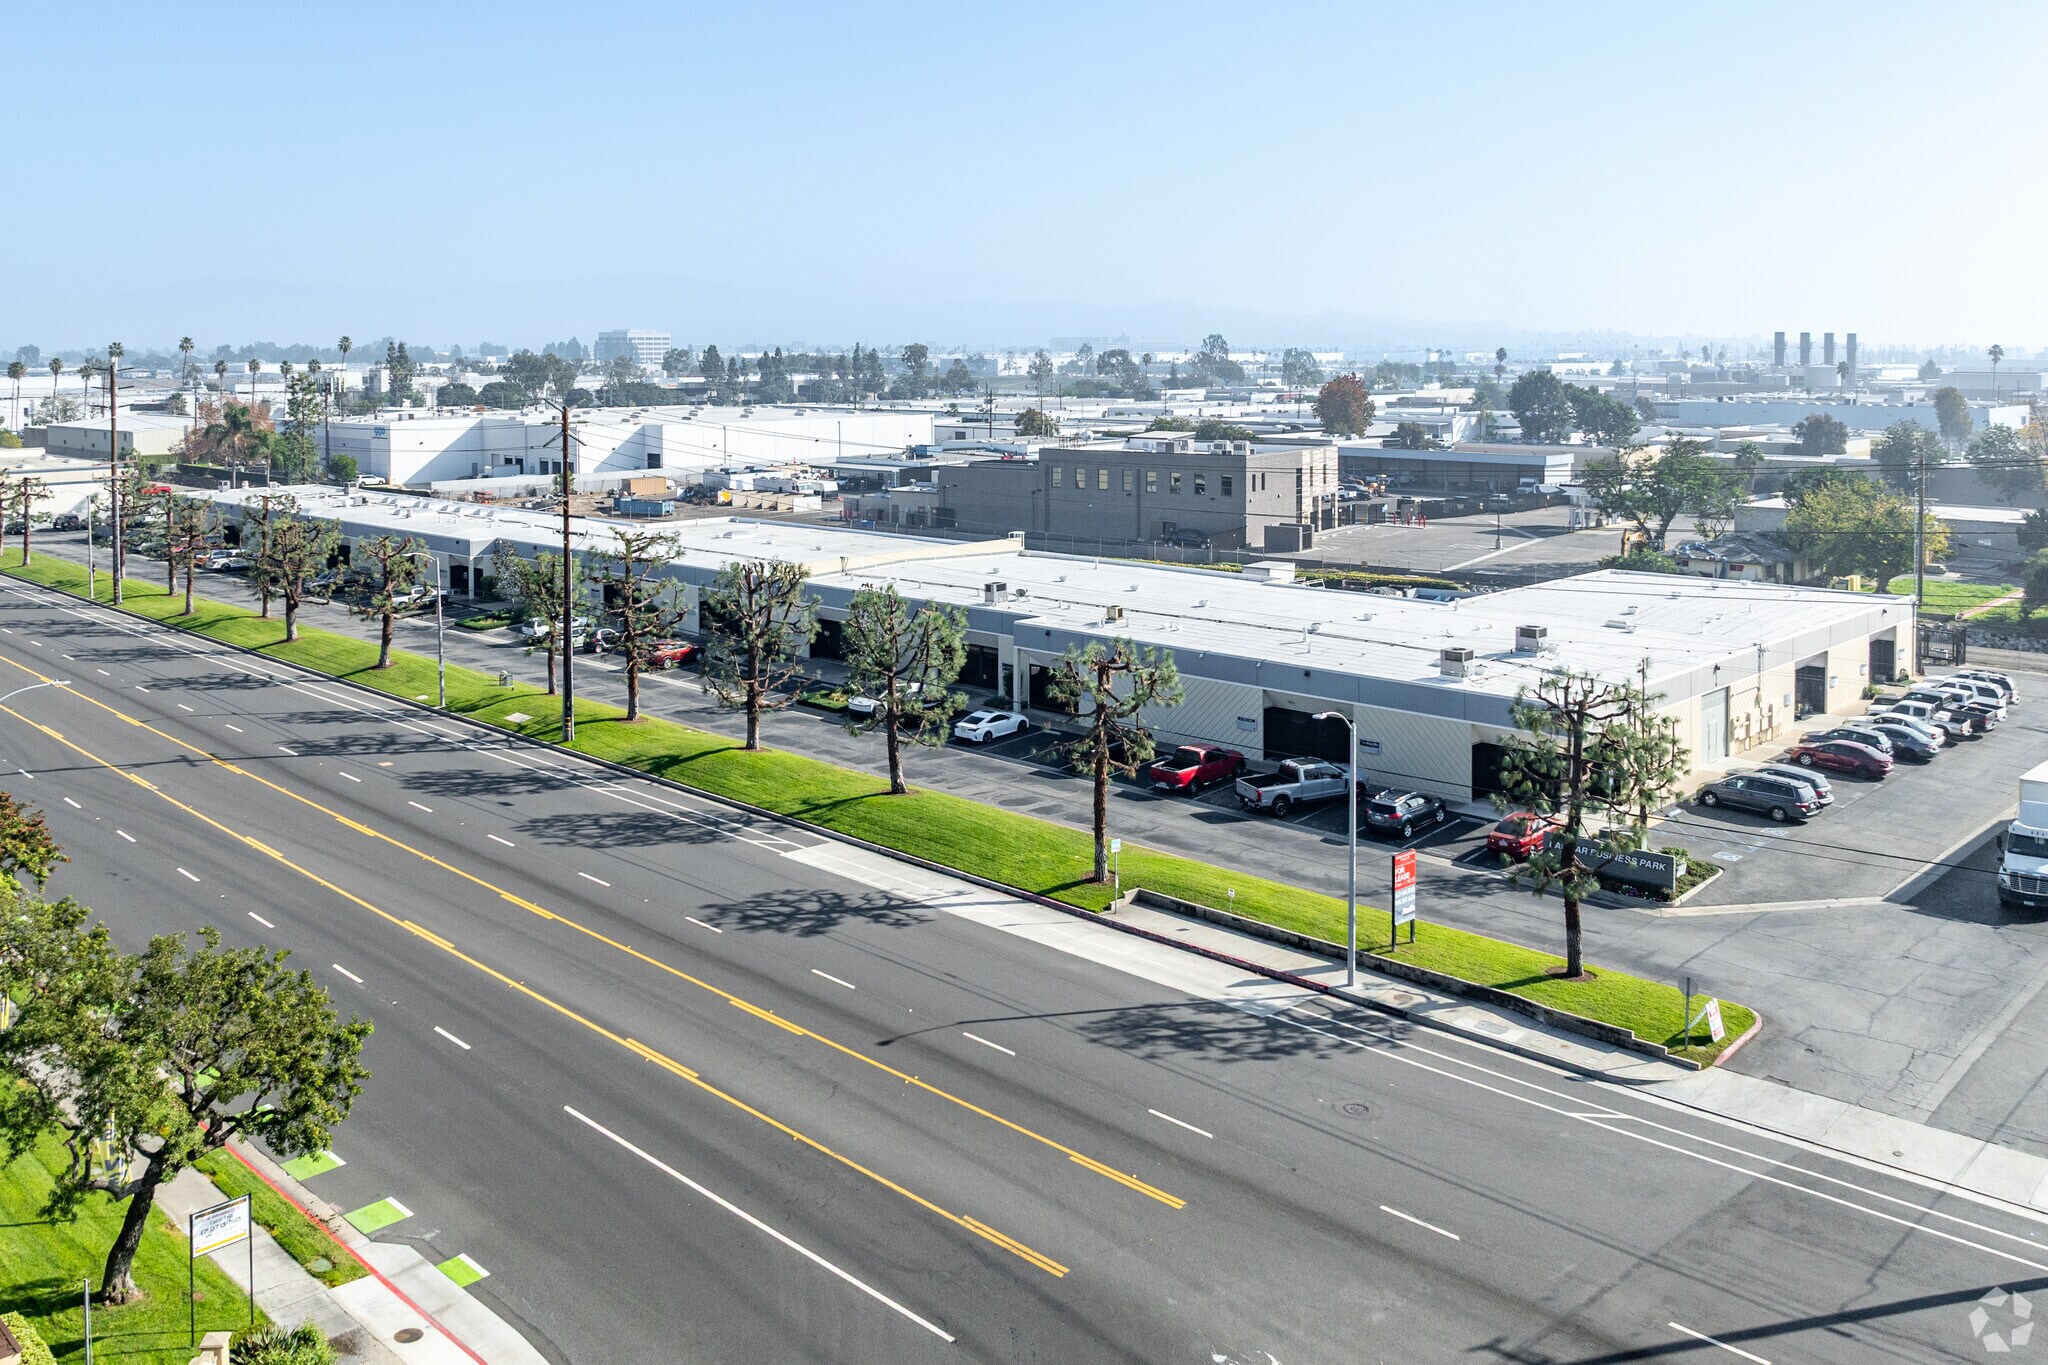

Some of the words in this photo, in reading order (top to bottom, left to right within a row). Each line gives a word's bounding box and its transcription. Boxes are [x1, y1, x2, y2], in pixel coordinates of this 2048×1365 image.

[1549, 841, 1588, 855] LAAR
[1639, 858, 1667, 872] PARK
[1395, 867, 1405, 875] FOR
[1395, 872, 1410, 882] LEASE
